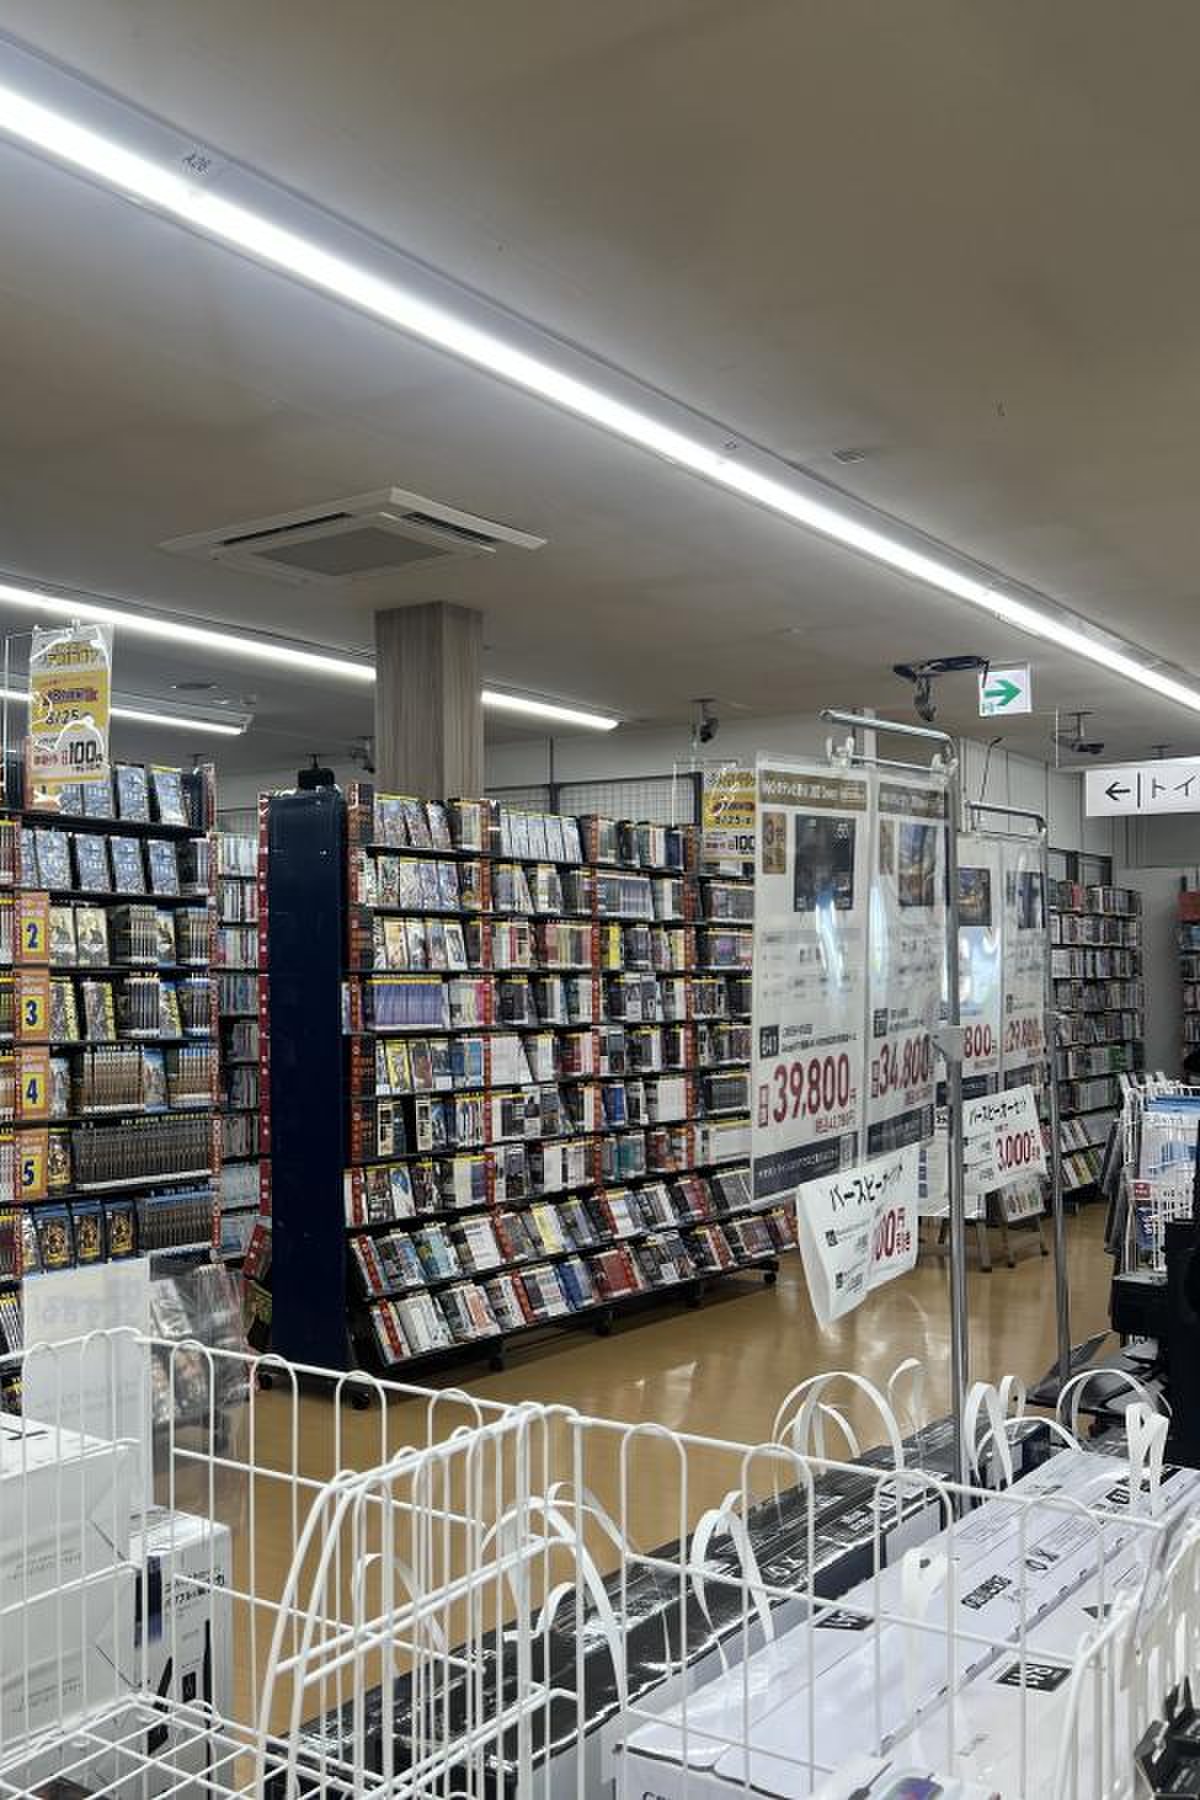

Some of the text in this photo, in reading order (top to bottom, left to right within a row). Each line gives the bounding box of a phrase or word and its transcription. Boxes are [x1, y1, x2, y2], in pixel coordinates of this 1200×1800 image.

[26, 922, 38, 949] 2
[25, 1000, 37, 1026] 3
[26, 1079, 38, 1104] 4
[22, 1160, 35, 1185] 5
